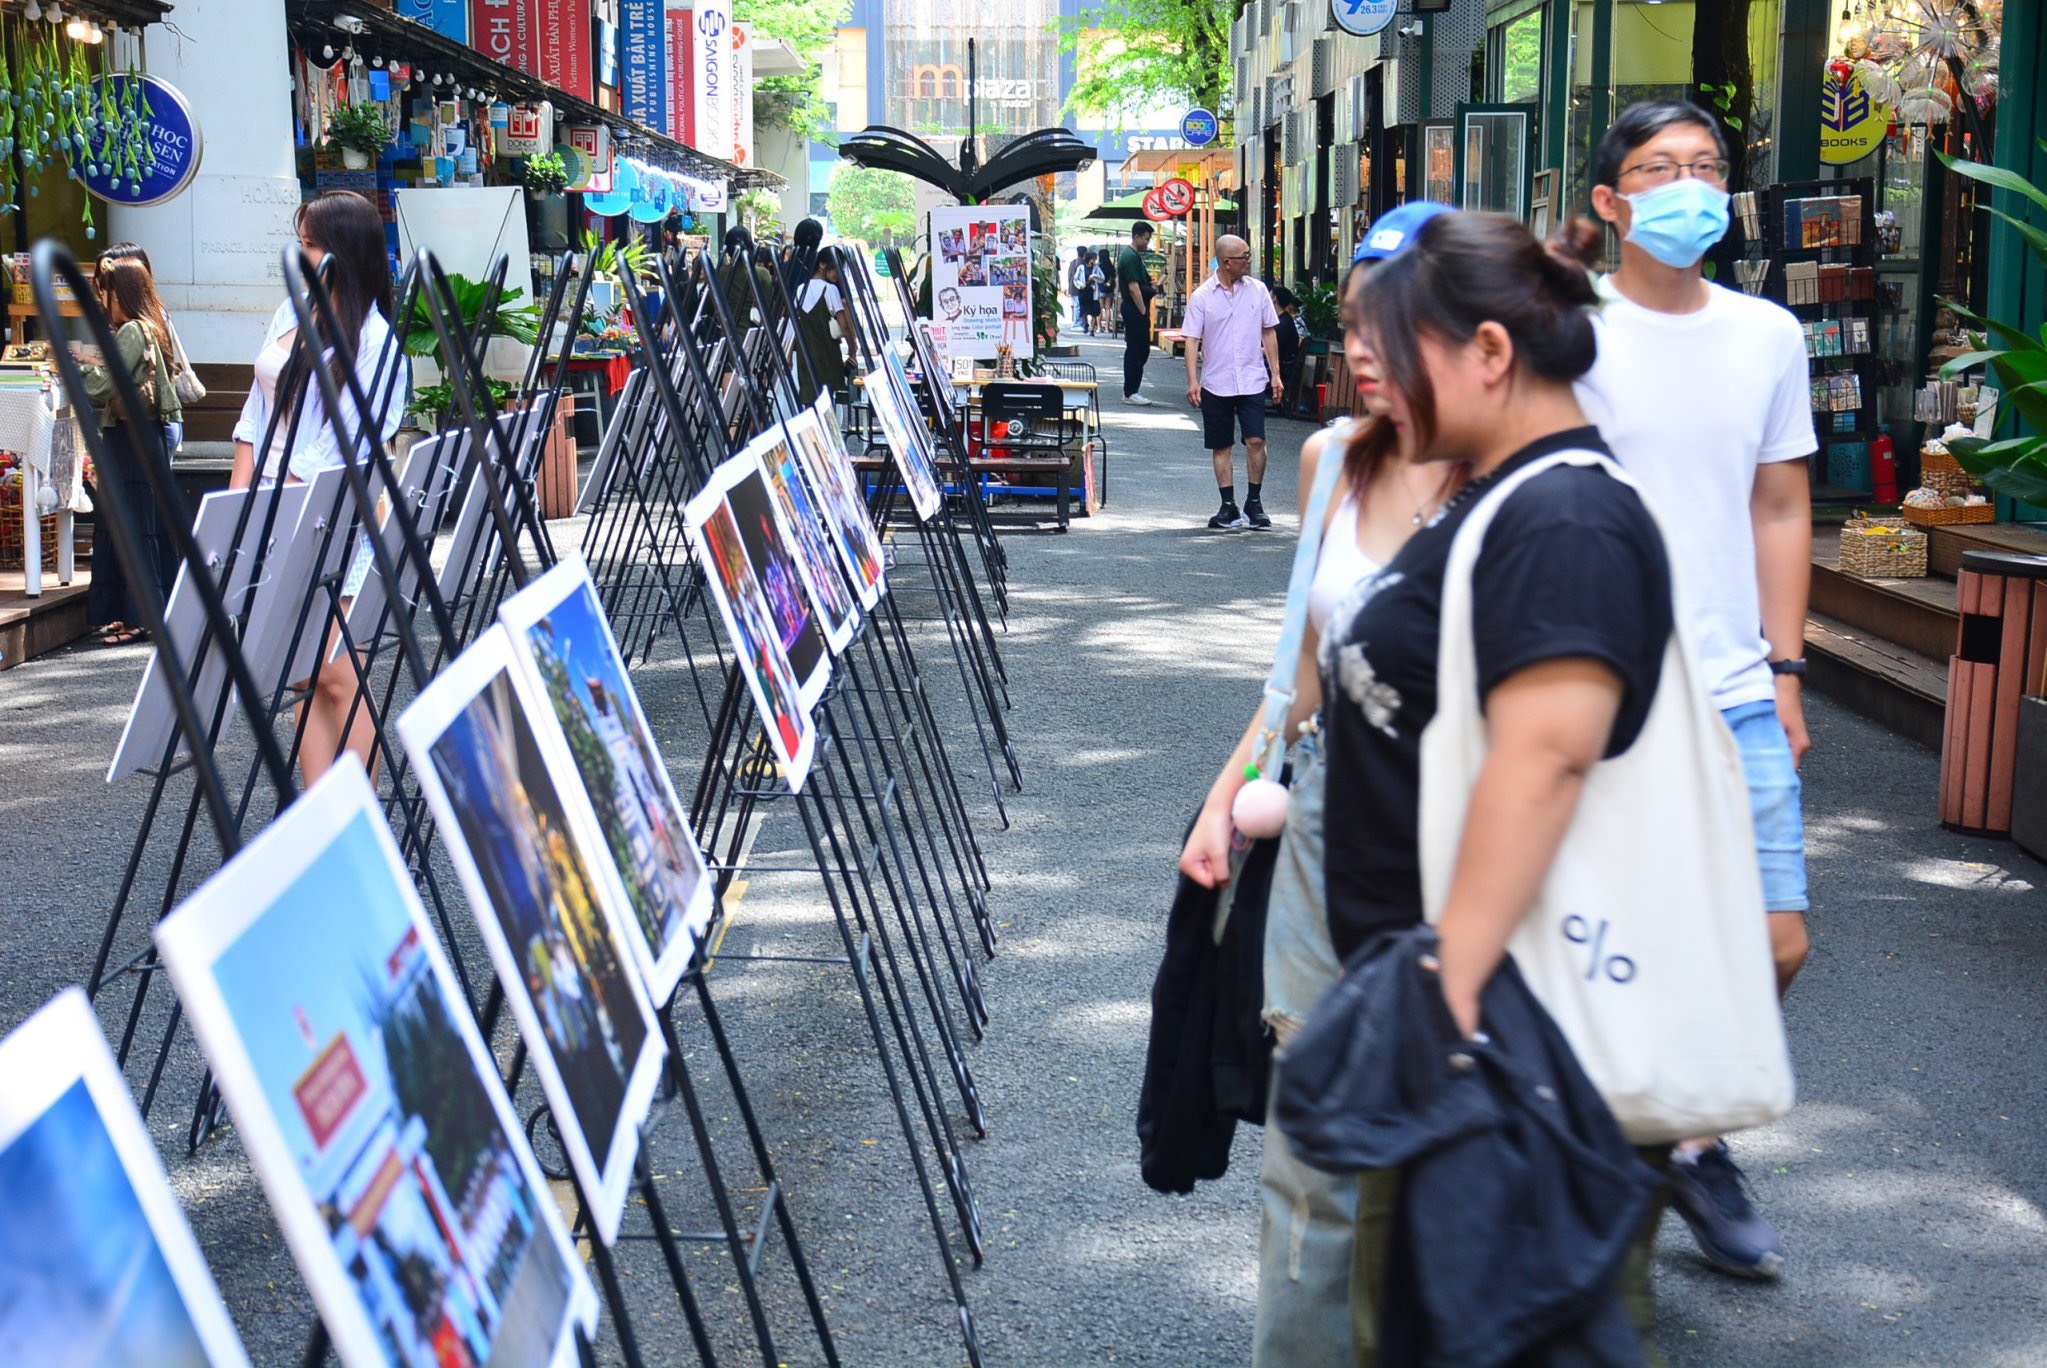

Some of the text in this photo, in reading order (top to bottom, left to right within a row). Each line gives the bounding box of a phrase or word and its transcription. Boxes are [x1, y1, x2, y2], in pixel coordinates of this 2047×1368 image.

[624, 2, 645, 30] TRẺ
[646, 1, 656, 37] HOUSE
[1360, 5, 1377, 14] 26.3
[546, 21, 561, 45] BẢN
[567, 14, 577, 52] Women's
[626, 32, 646, 65] BẢN
[545, 43, 561, 79] XUẤT
[569, 53, 578, 89] Vietnam
[626, 67, 647, 104] XUẤT
[647, 43, 657, 113] PUBLISHING
[151, 124, 188, 149] HỌC
[152, 141, 184, 163] SEN
[963, 304, 998, 318] Ký họa
